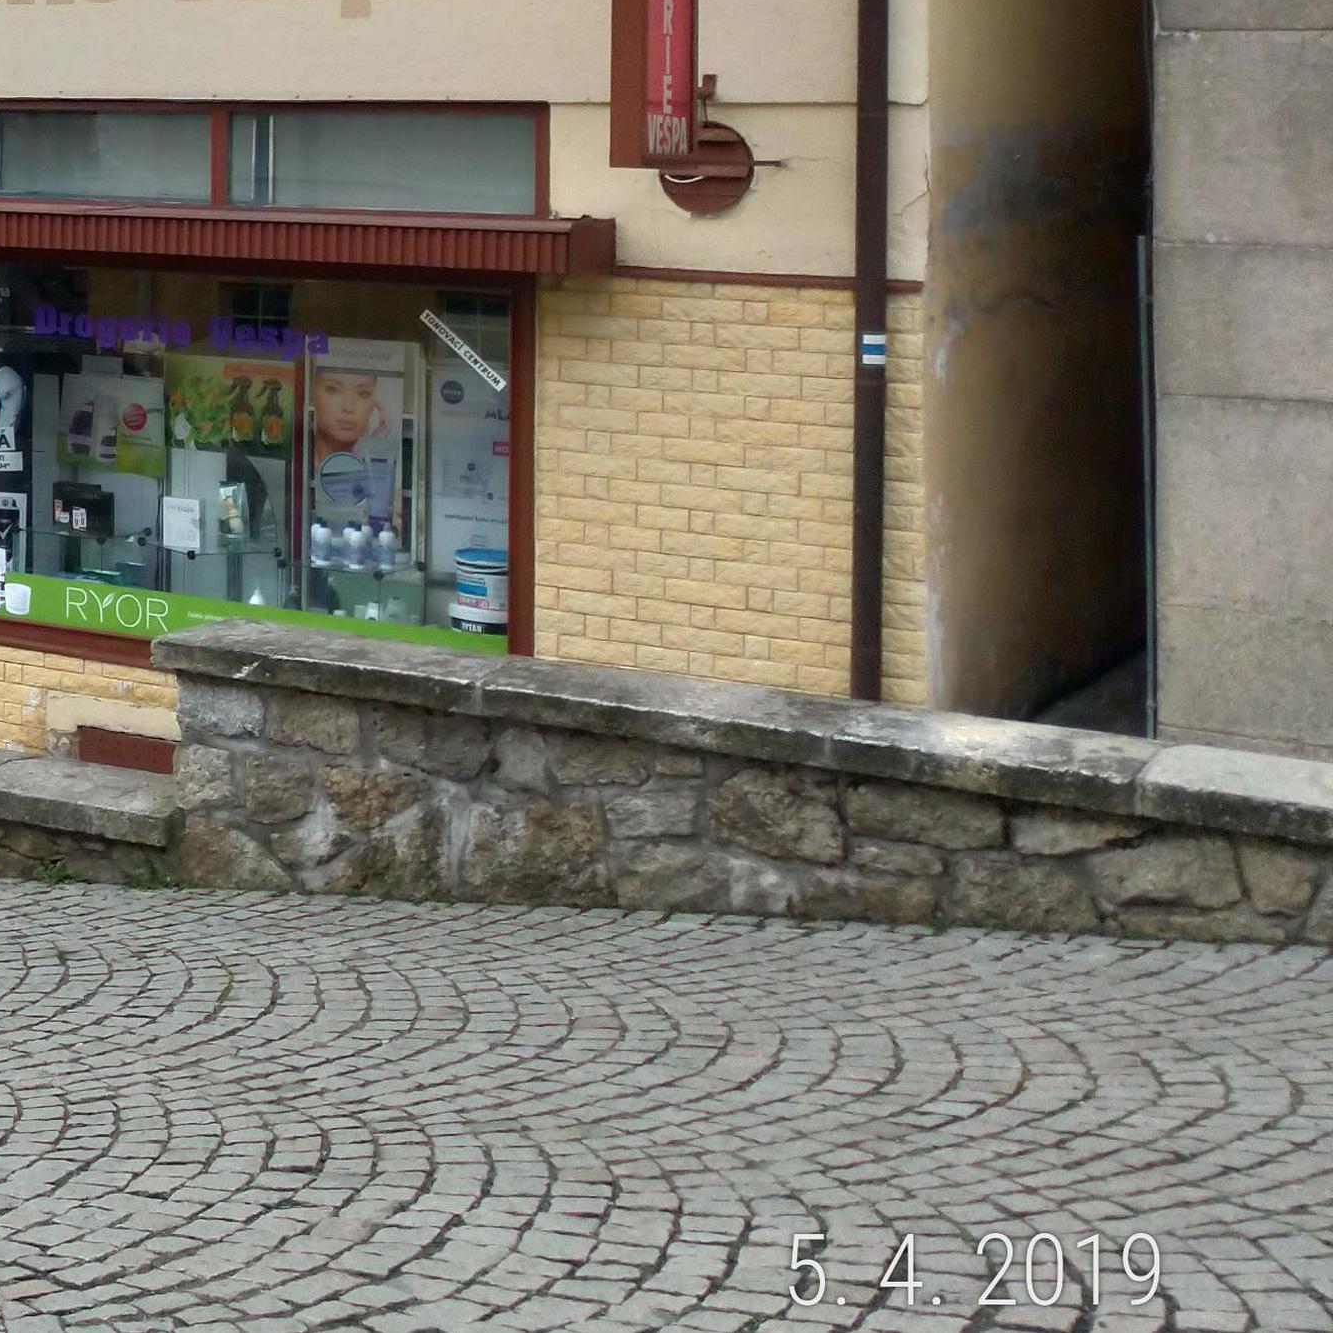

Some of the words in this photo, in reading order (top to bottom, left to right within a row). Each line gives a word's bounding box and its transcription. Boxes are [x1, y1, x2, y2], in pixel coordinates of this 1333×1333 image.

[647, 114, 688, 155] VESPA
[423, 312, 465, 351] TONOVACÍ
[463, 349, 501, 388] CENTRUM
[65, 586, 169, 633] RYOR
